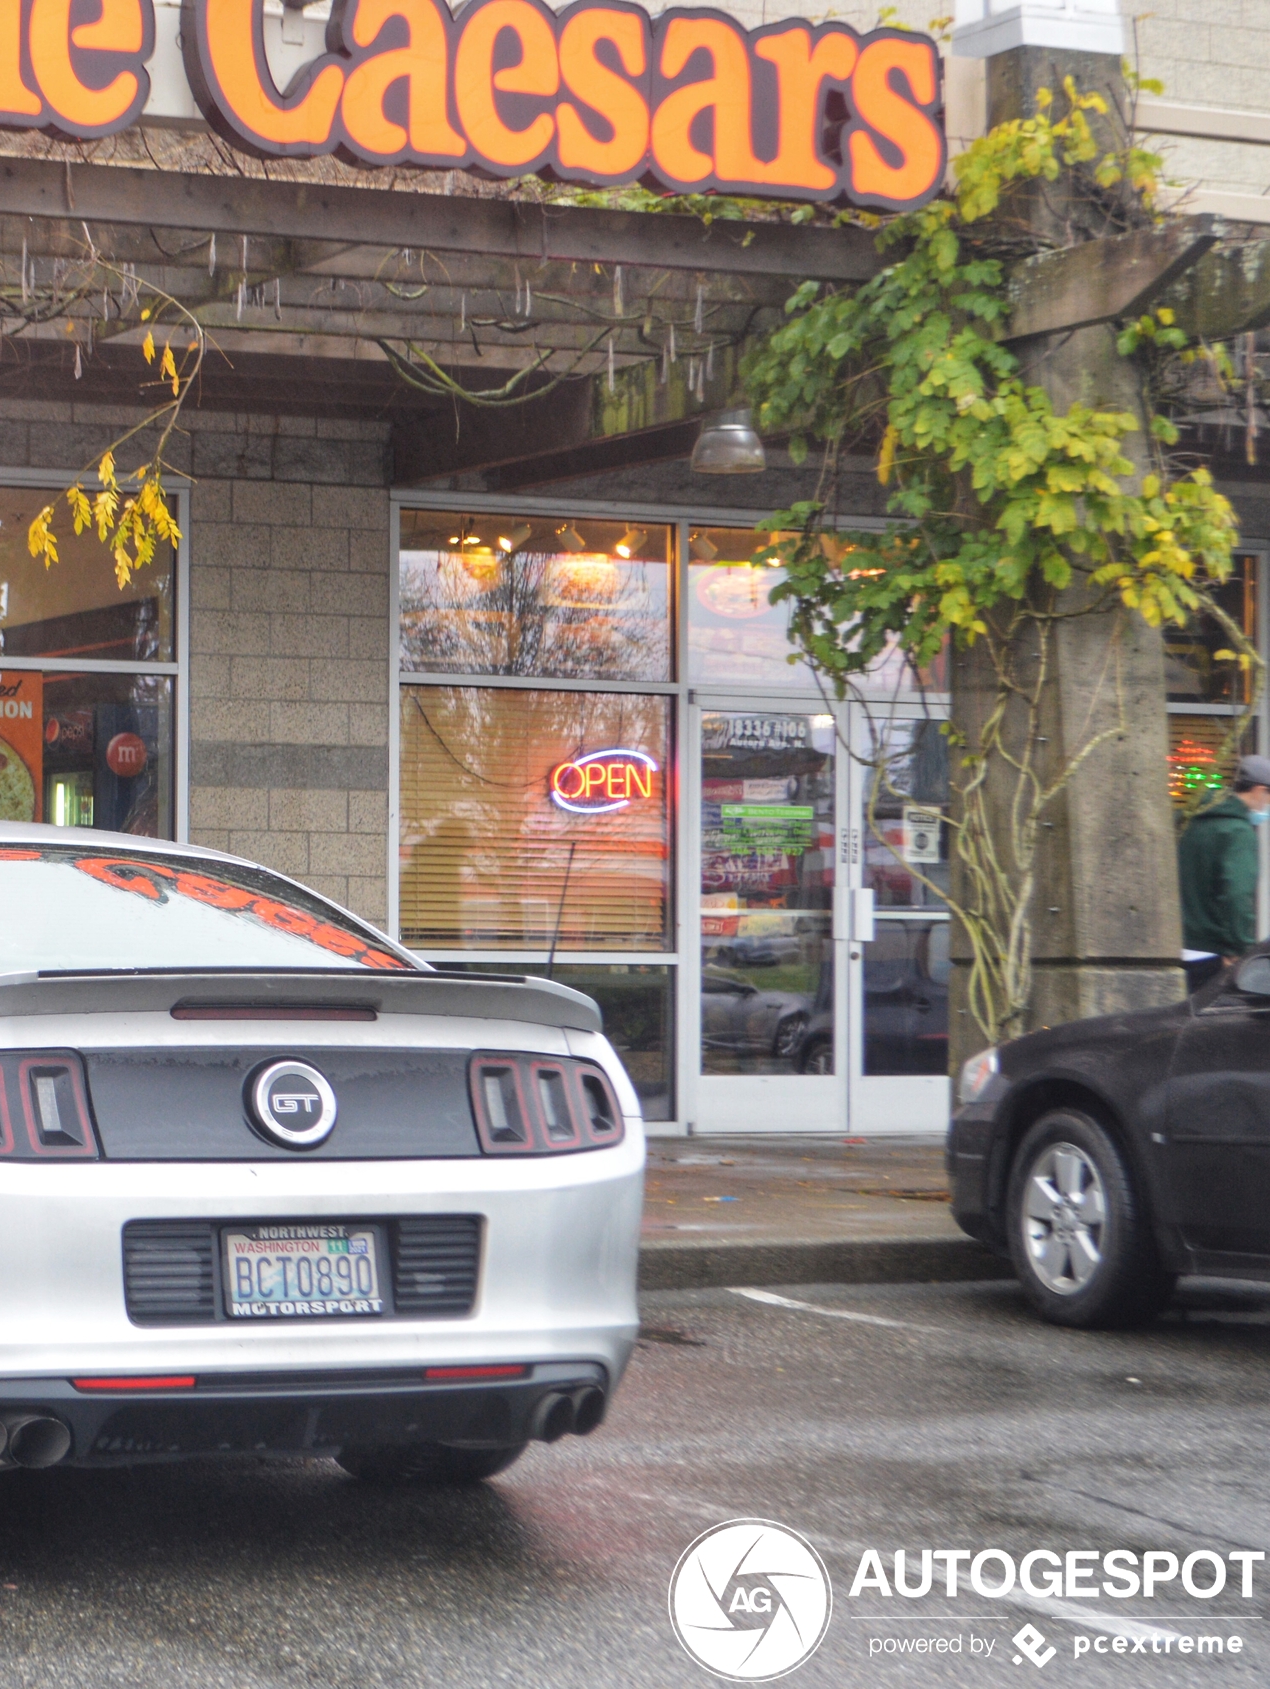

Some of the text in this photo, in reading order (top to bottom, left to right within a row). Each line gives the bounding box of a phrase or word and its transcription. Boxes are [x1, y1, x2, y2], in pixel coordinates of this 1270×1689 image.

[207, 0, 942, 200] Caesars
[730, 719, 806, 738] 18336 #106
[117, 745, 136, 763] m
[552, 762, 652, 799] OPEN
[273, 1094, 319, 1113] GT
[258, 1225, 345, 1239] NORTHWEST
[234, 1241, 320, 1254] WASHINGTON
[235, 1255, 373, 1299] BCT0890
[232, 1299, 383, 1316] MOTORSPORT
